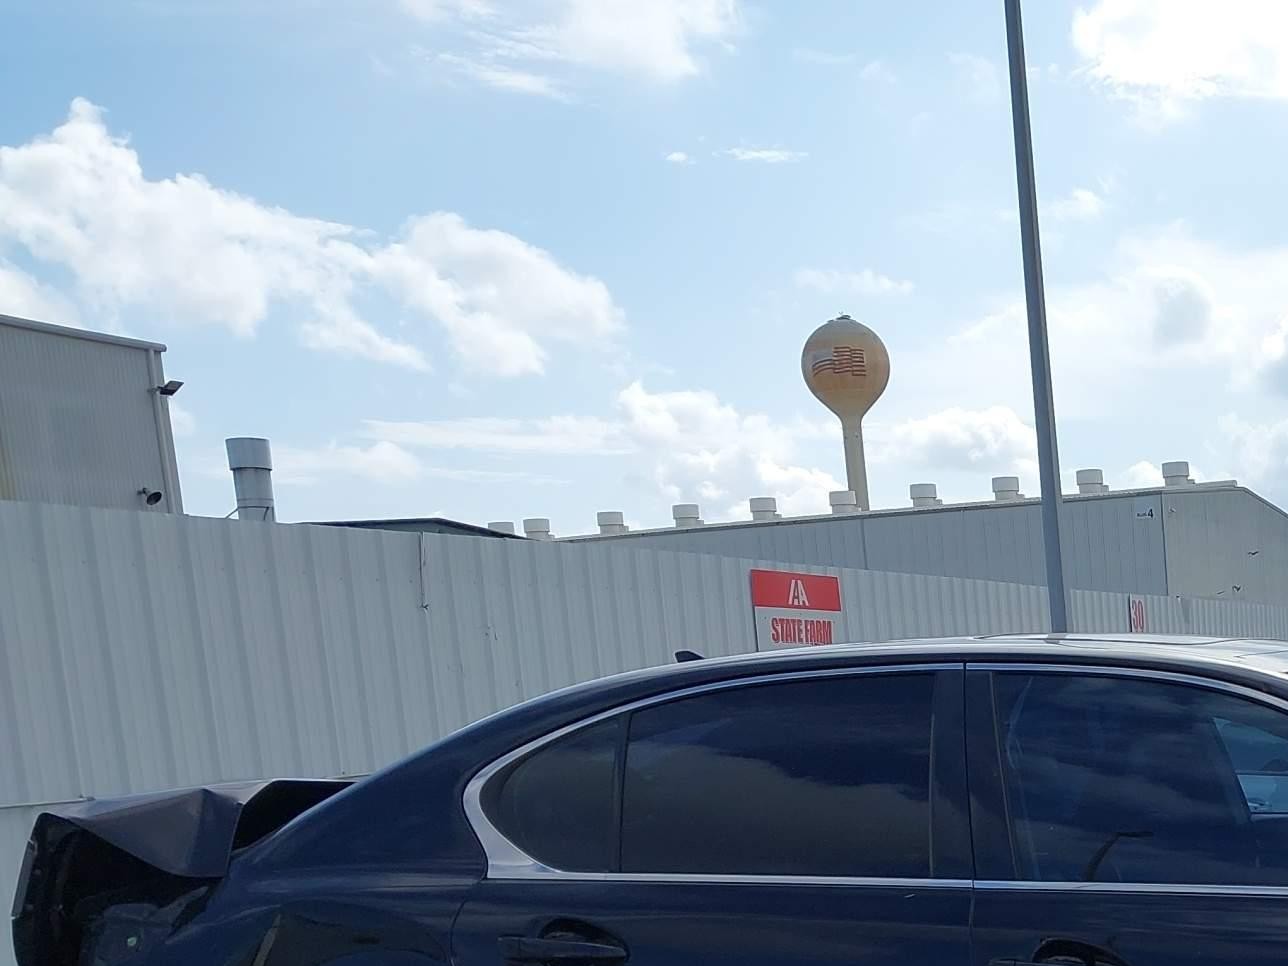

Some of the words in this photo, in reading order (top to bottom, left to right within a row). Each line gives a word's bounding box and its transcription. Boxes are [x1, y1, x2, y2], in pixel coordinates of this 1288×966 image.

[1131, 600, 1144, 630] 30
[771, 618, 803, 643] STATE
[804, 620, 832, 644] FARM
